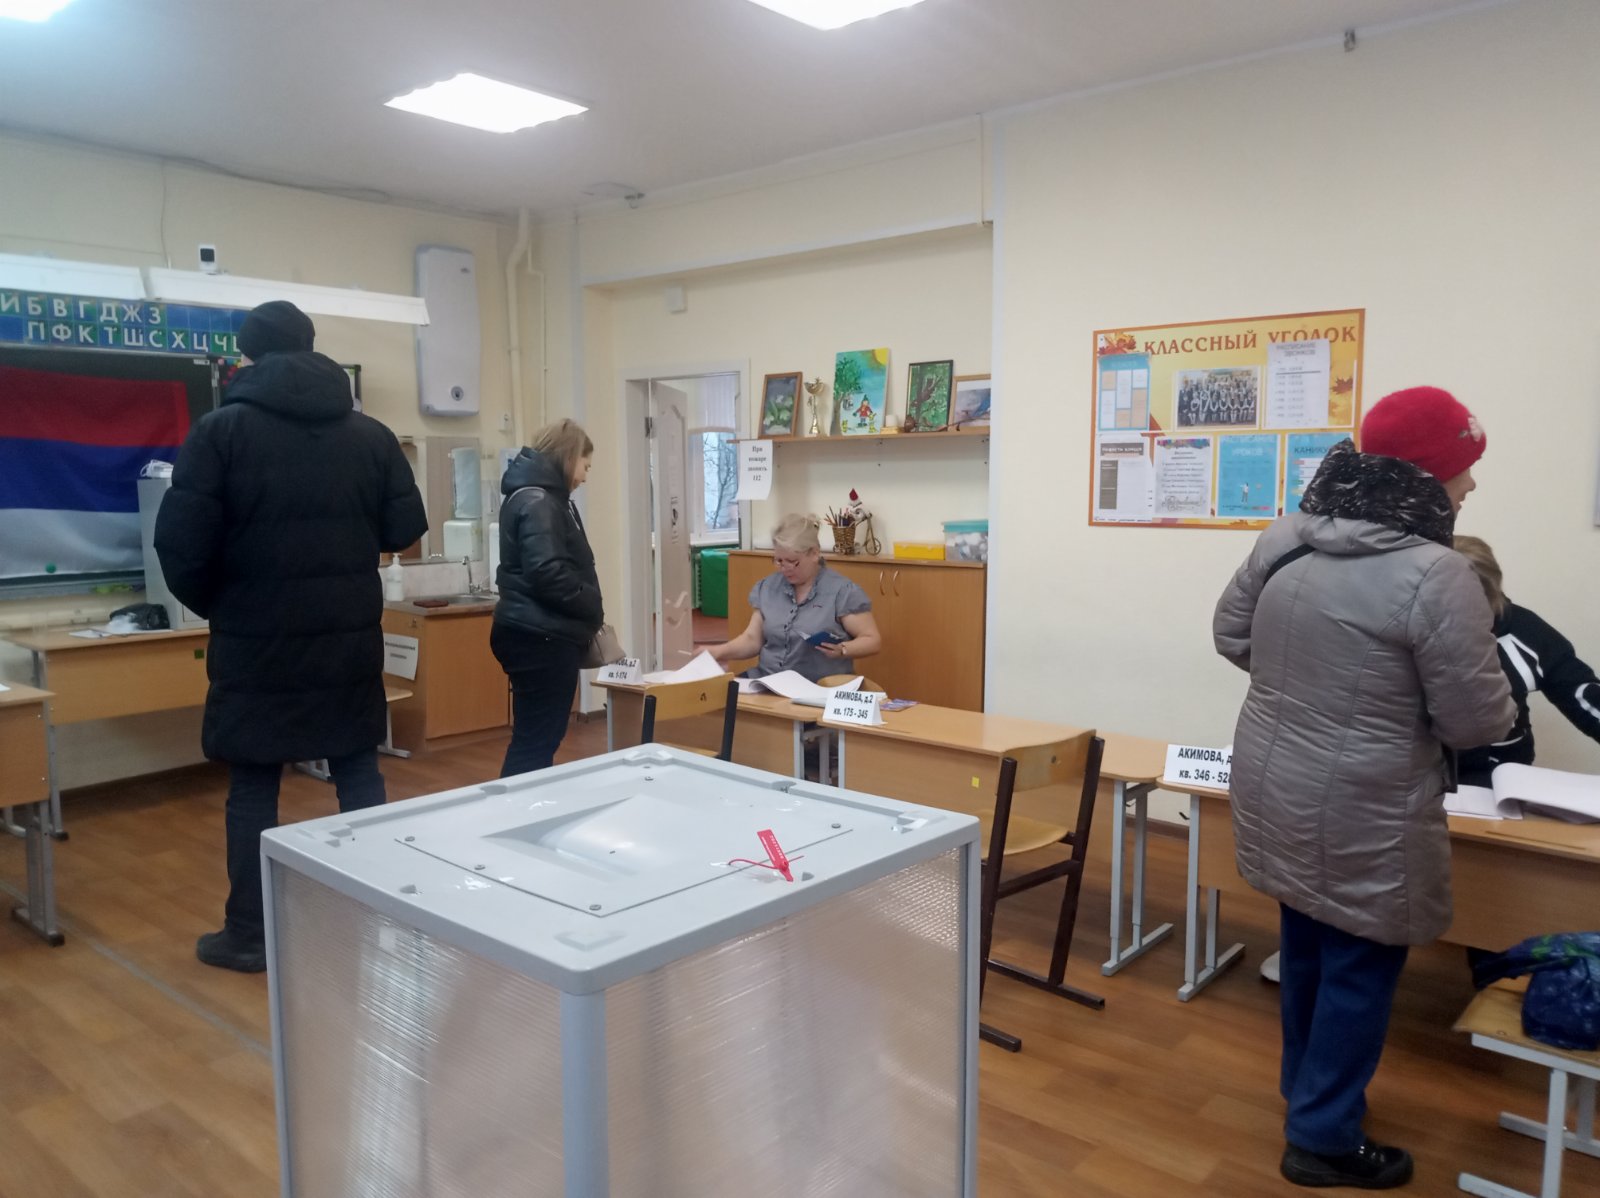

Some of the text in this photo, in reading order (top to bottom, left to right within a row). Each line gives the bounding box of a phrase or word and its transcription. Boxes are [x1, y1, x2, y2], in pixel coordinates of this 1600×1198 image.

[1144, 326, 1356, 355] КЛАССНЫЙ УГОЛОК
[834, 690, 863, 703] АКИМОВА,
[1178, 747, 1224, 765] АКИМОВА,
[1179, 769, 1191, 779] кв.
[1194, 768, 1210, 781] 346
